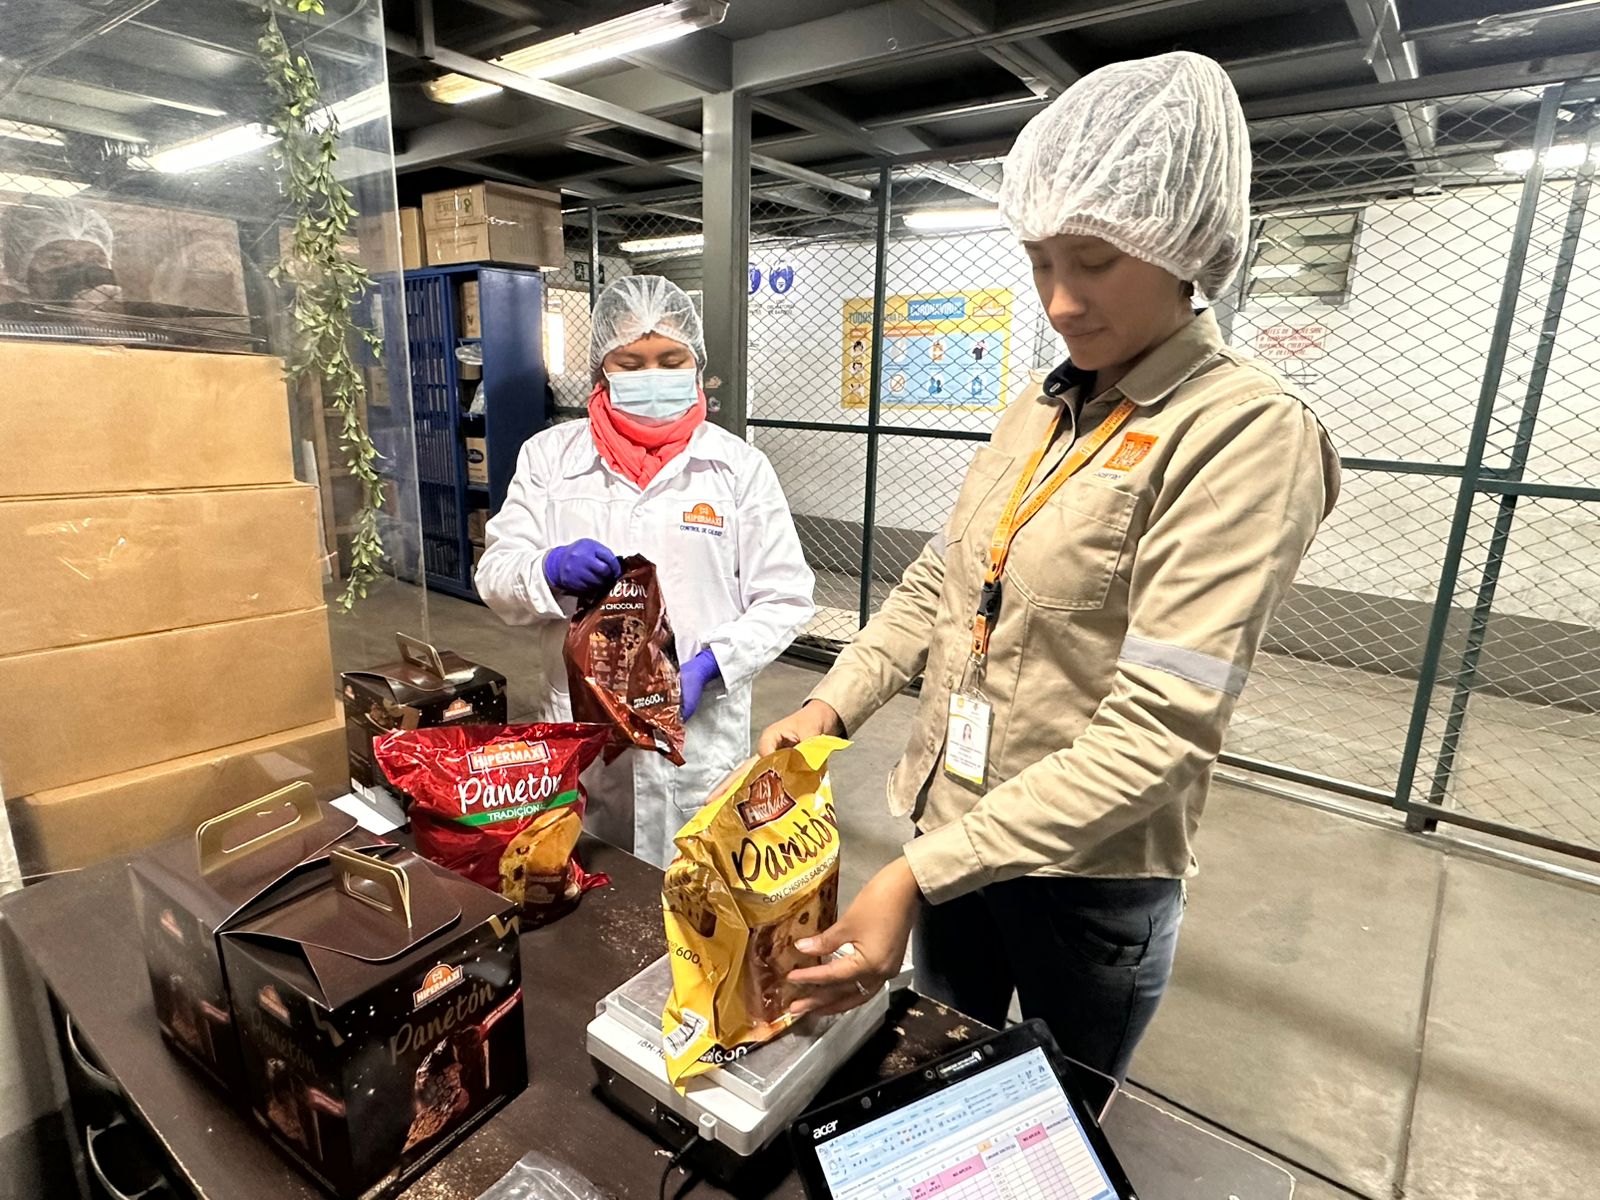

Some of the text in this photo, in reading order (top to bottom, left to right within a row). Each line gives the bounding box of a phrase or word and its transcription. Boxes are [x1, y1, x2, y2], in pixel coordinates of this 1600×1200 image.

[473, 746, 547, 768] HIPERMAXI
[458, 765, 563, 814] Panetón
[762, 861, 829, 903] CON CHISPAS SABOR
[416, 968, 460, 1004] HIPERMAXI
[390, 984, 496, 1065] Panetón
[812, 1119, 839, 1140] acer
